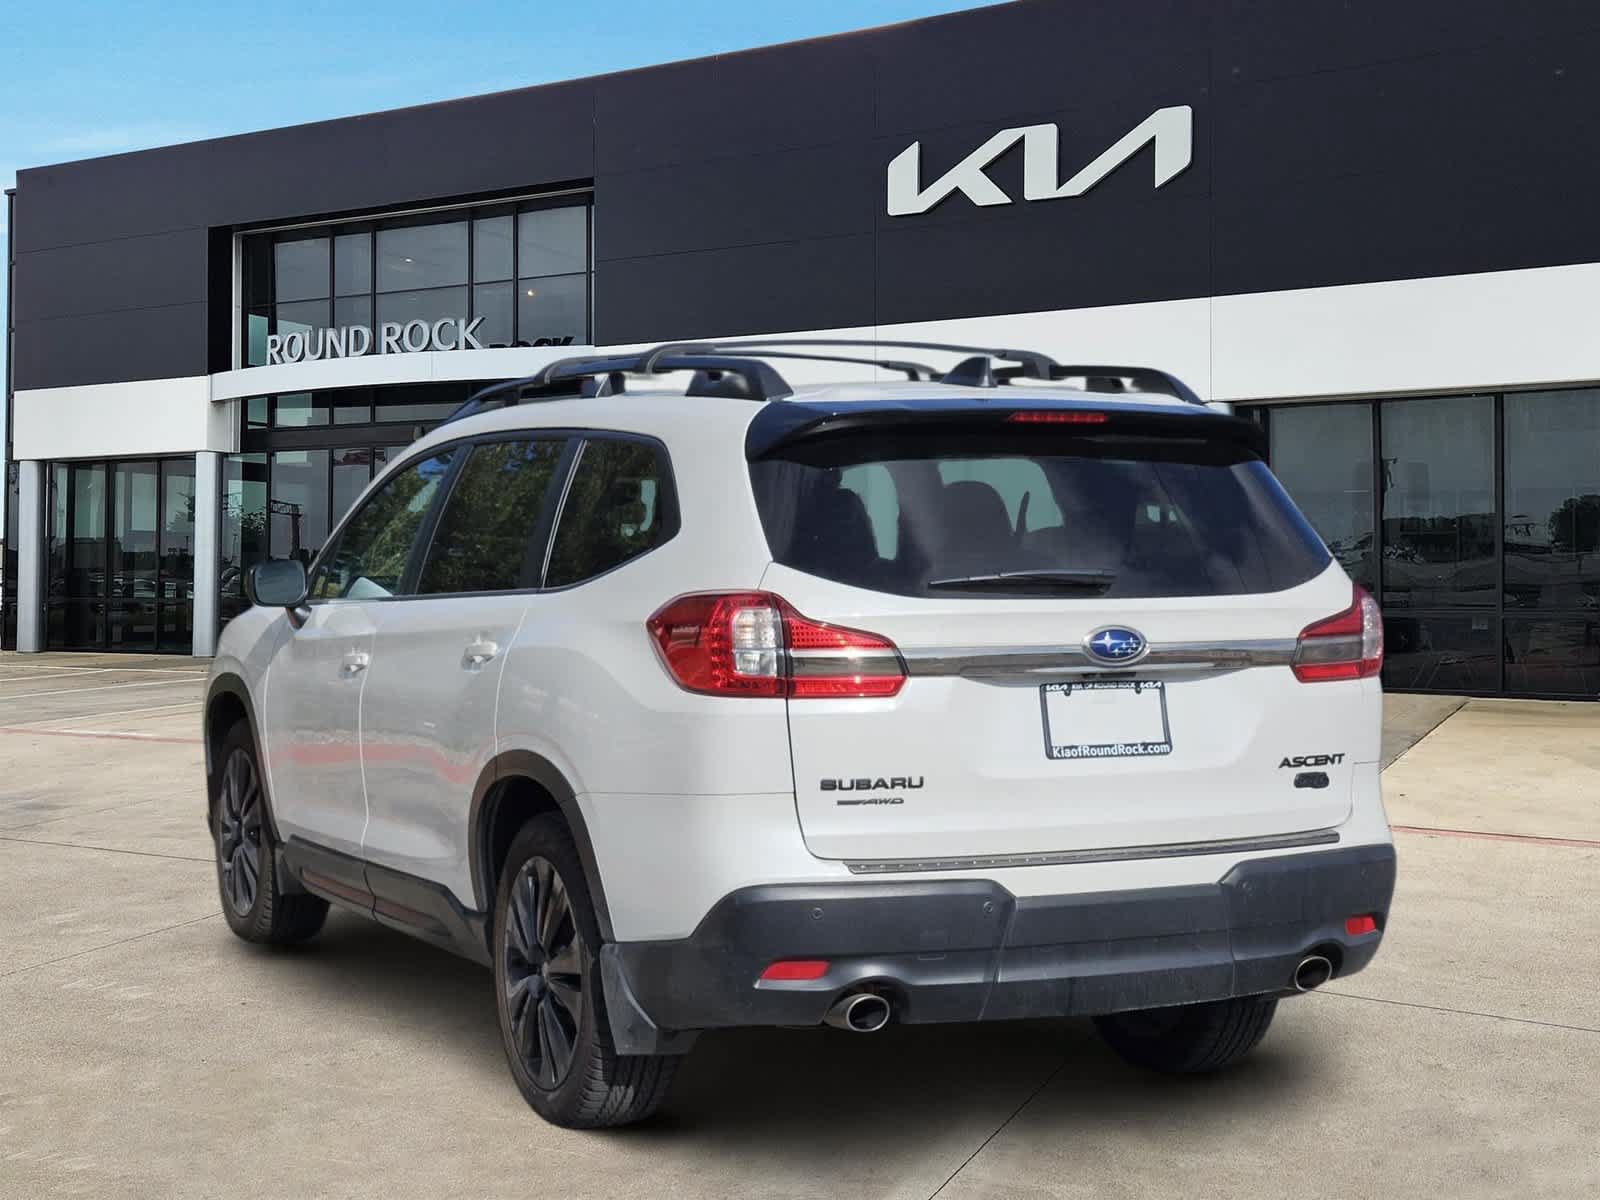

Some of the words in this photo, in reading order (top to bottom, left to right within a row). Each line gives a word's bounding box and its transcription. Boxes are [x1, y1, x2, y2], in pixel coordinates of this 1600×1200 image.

[887, 105, 1192, 216] KIA
[266, 325, 371, 366] ROUND
[380, 317, 485, 354] ROCK
[1052, 743, 1170, 758] KiaofRoundRock.com
[1278, 753, 1345, 769] ASCENT
[820, 776, 924, 791] SUBARU
